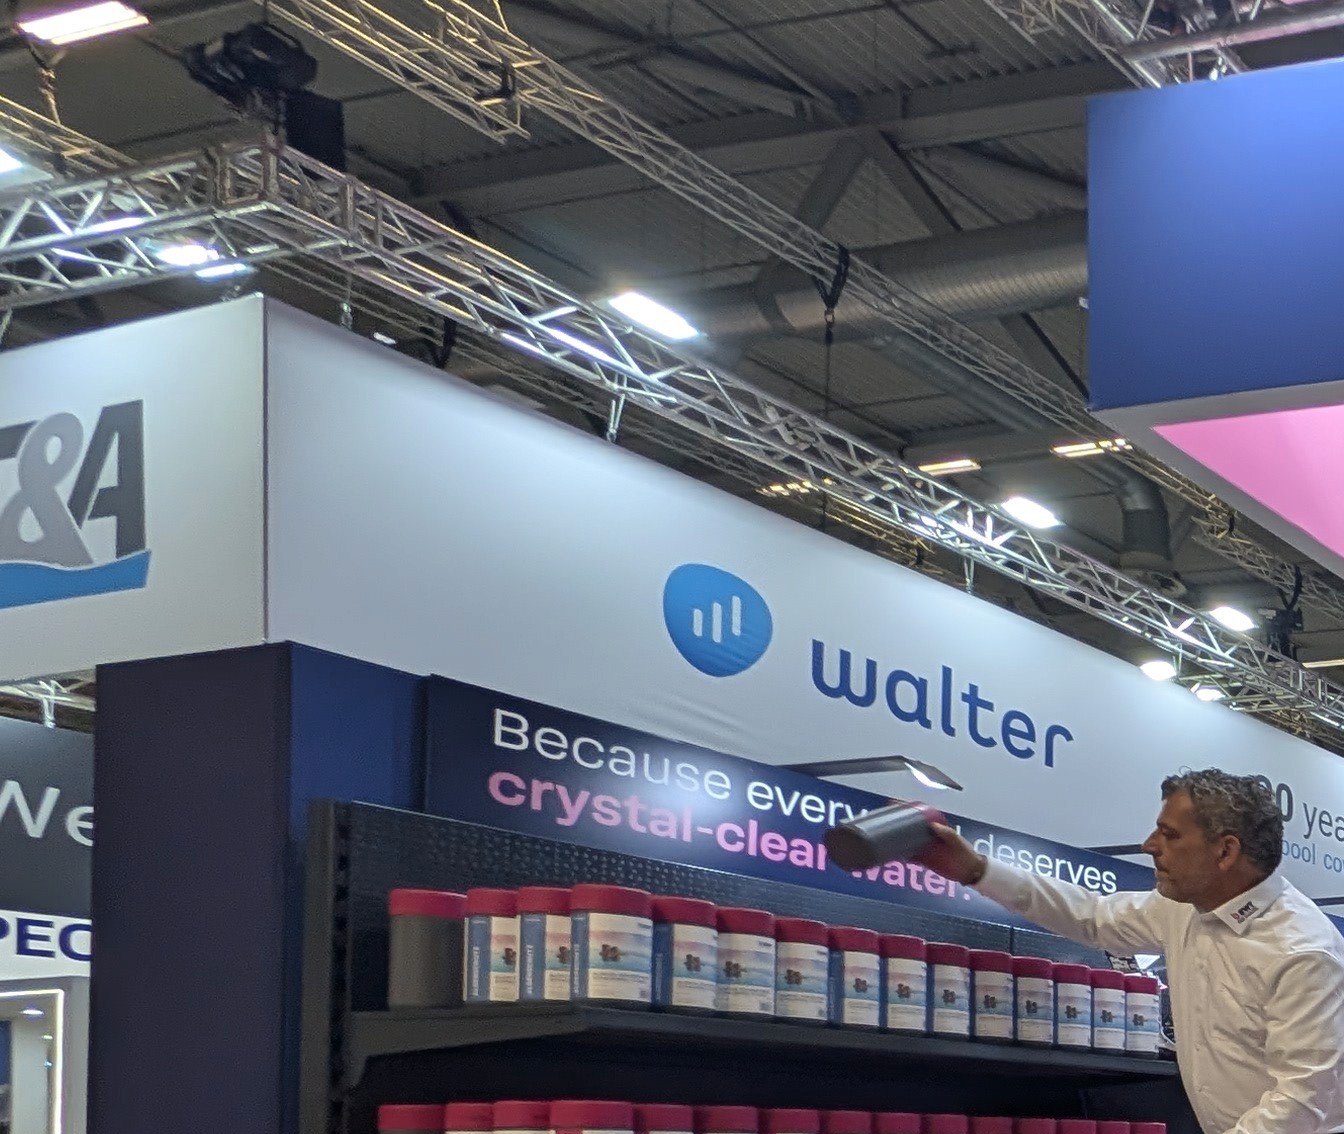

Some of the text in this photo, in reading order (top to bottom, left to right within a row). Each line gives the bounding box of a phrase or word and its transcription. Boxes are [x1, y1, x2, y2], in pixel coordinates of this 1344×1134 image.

[811, 638, 1074, 768] walter
[487, 771, 827, 870] crystal-clear
[493, 708, 732, 800] Because
[973, 833, 1118, 893] deserves
